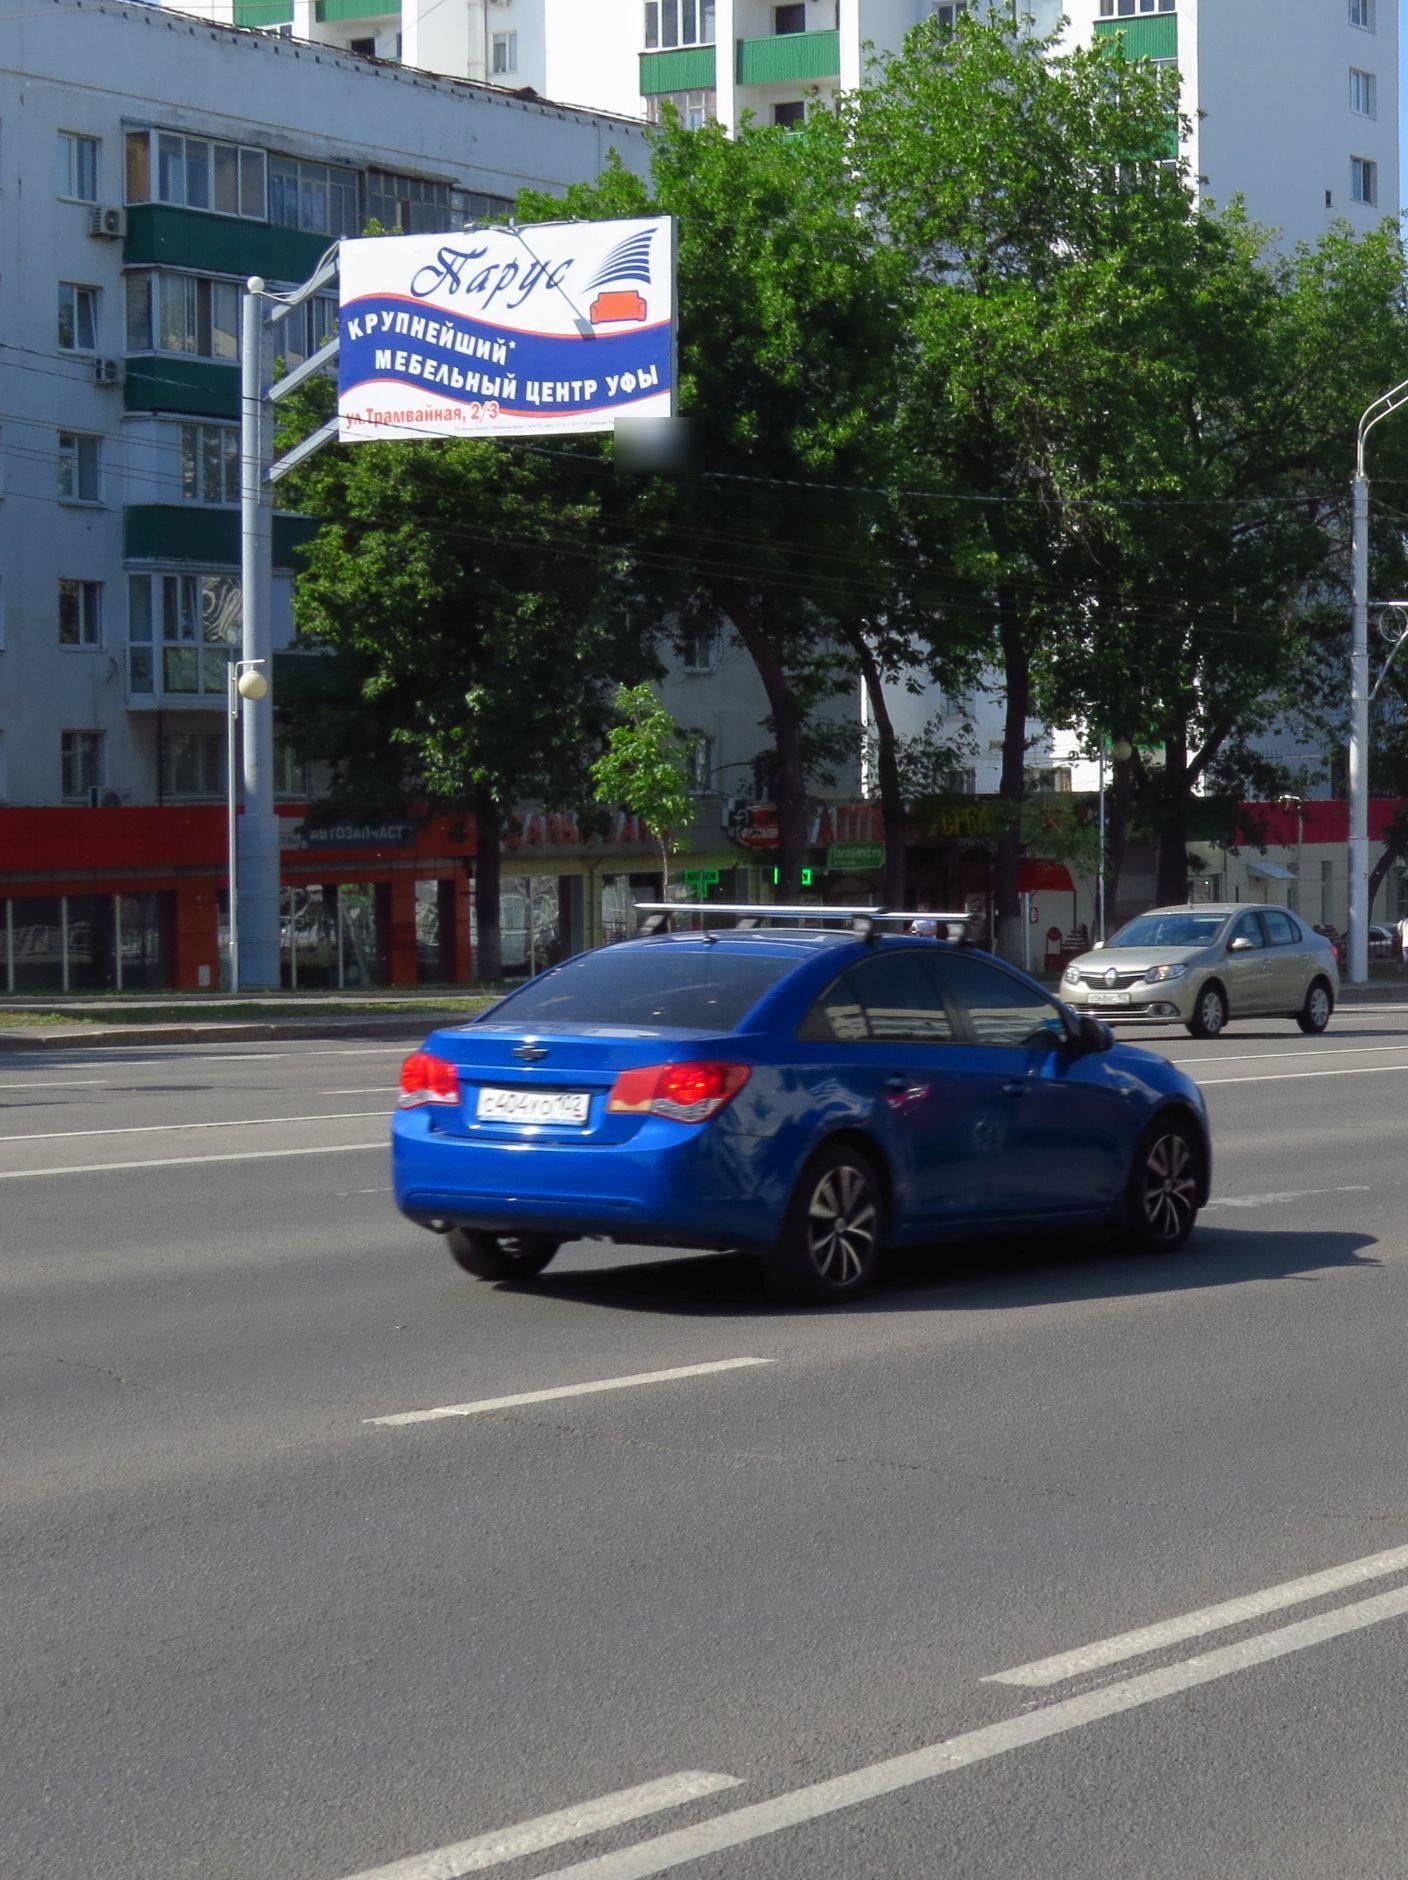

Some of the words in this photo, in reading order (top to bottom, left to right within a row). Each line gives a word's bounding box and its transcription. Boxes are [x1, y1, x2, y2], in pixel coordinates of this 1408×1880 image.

[411, 246, 576, 311] Парус
[375, 349, 518, 400] МЕБЕЛЬНЫЙ
[525, 379, 598, 405] ЦЕНТР
[605, 364, 659, 397] УФЫ
[470, 401, 499, 423] 2/3
[310, 823, 407, 841] АВТОЗАПЧАСТ
